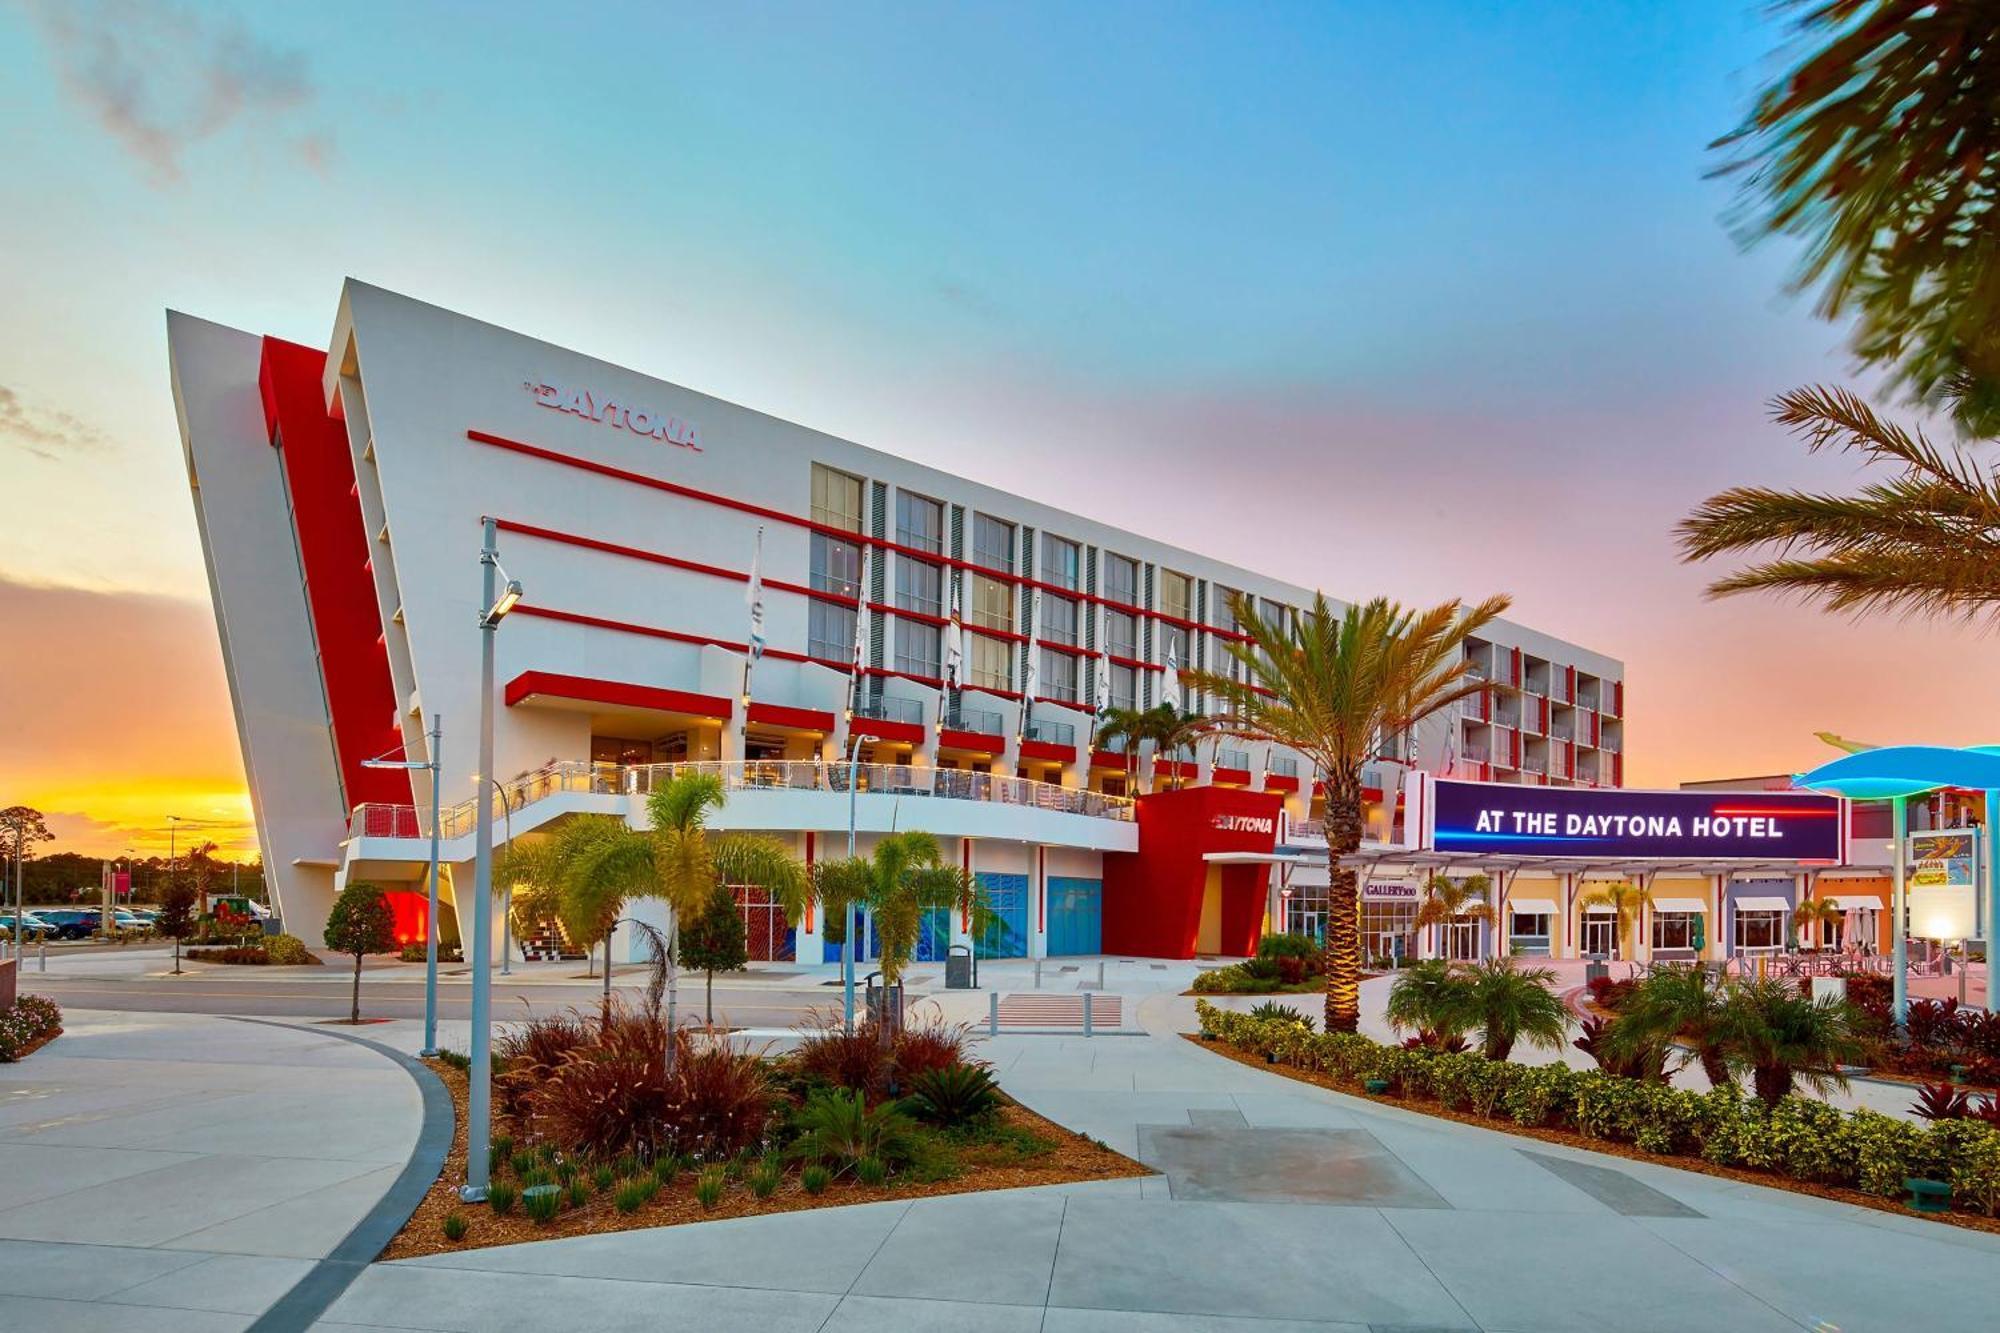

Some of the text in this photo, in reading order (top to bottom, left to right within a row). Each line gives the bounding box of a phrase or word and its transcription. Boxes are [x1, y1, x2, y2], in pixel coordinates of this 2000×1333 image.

[535, 381, 704, 453] DAYTONA
[1215, 815, 1273, 833] DAYTONA
[1476, 809, 1783, 838] AT THE DAYTONA HOTEL
